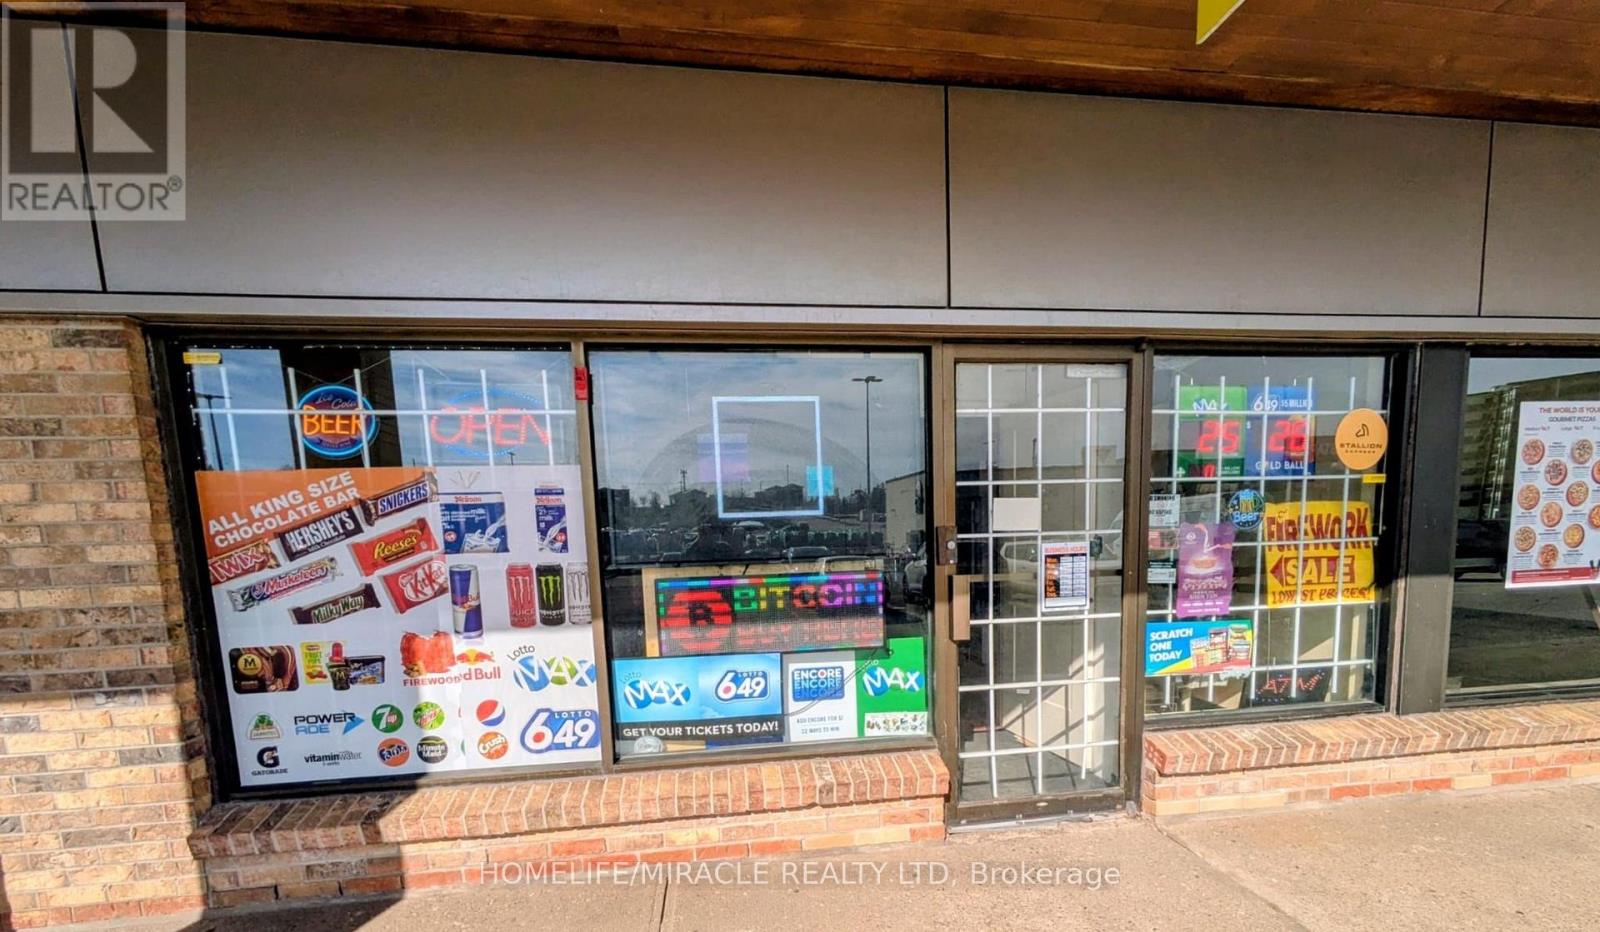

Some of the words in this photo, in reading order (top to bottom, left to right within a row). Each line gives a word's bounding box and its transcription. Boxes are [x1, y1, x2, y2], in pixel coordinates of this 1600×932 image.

[303, 404, 367, 439] BEER
[430, 407, 549, 446] OPEN
[208, 512, 249, 536] ALL
[250, 490, 304, 520] KING
[310, 470, 355, 499] SIZE
[377, 481, 429, 514] SNICKERS
[214, 503, 321, 548] CHOCOLATE
[325, 487, 361, 509] BAR
[1232, 511, 1259, 522] Beer
[288, 512, 356, 554] HERSHEY'S
[1266, 508, 1371, 552] FIREWORK
[374, 535, 417, 560] Reese's
[1286, 556, 1353, 584] SALE
[1272, 588, 1317, 604] LOWST
[1149, 628, 1194, 642] SCRATCH
[506, 644, 536, 662] Lotto
[1149, 650, 1182, 662] TODAY
[1150, 641, 1172, 652] ONE
[474, 666, 502, 680] Bull
[513, 655, 597, 692] MAX
[619, 670, 650, 684] Lotto
[794, 668, 842, 680] ENCORE
[862, 667, 921, 697] MAX
[624, 678, 691, 709] MAX
[718, 672, 766, 700] 649
[794, 678, 842, 690] ENCORE
[294, 712, 356, 725] POWER
[554, 710, 592, 719] LOTTO
[524, 711, 596, 751] 649
[622, 726, 647, 738] GET
[649, 726, 682, 737] YOUR
[684, 724, 734, 736] TICKETS
[735, 721, 779, 734] TODAY!
[478, 734, 506, 754] Crush
[251, 768, 288, 776] GATORADE
